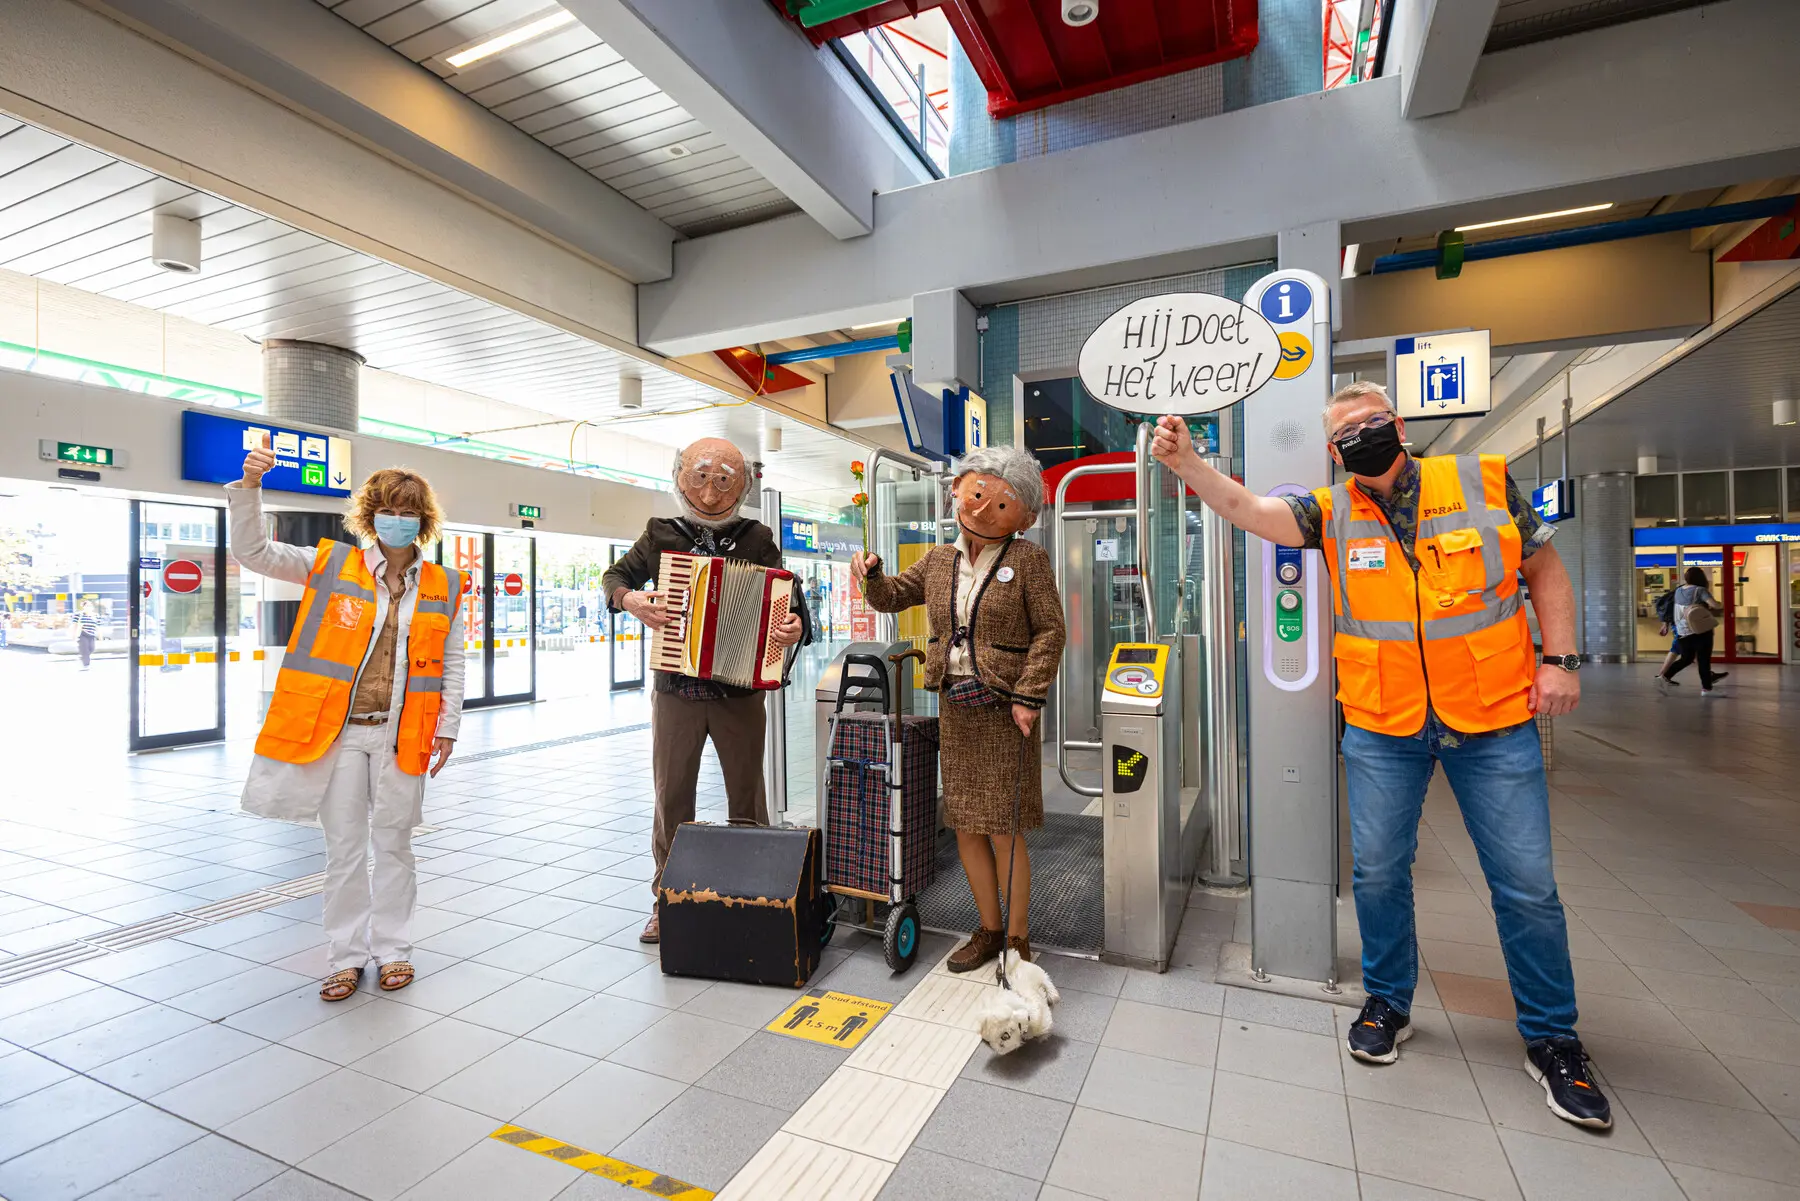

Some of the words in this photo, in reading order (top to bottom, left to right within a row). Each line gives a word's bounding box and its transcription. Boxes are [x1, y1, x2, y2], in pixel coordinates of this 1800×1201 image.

[1123, 308, 1173, 363] Hij
[1417, 342, 1432, 350] lift
[1104, 361, 1157, 400] Het
[275, 459, 299, 469] trum
[1755, 534, 1780, 542] GWK
[1780, 534, 1800, 542] Trav
[825, 994, 849, 1003] houd
[851, 998, 888, 1011] afstand
[825, 1024, 838, 1032] m
